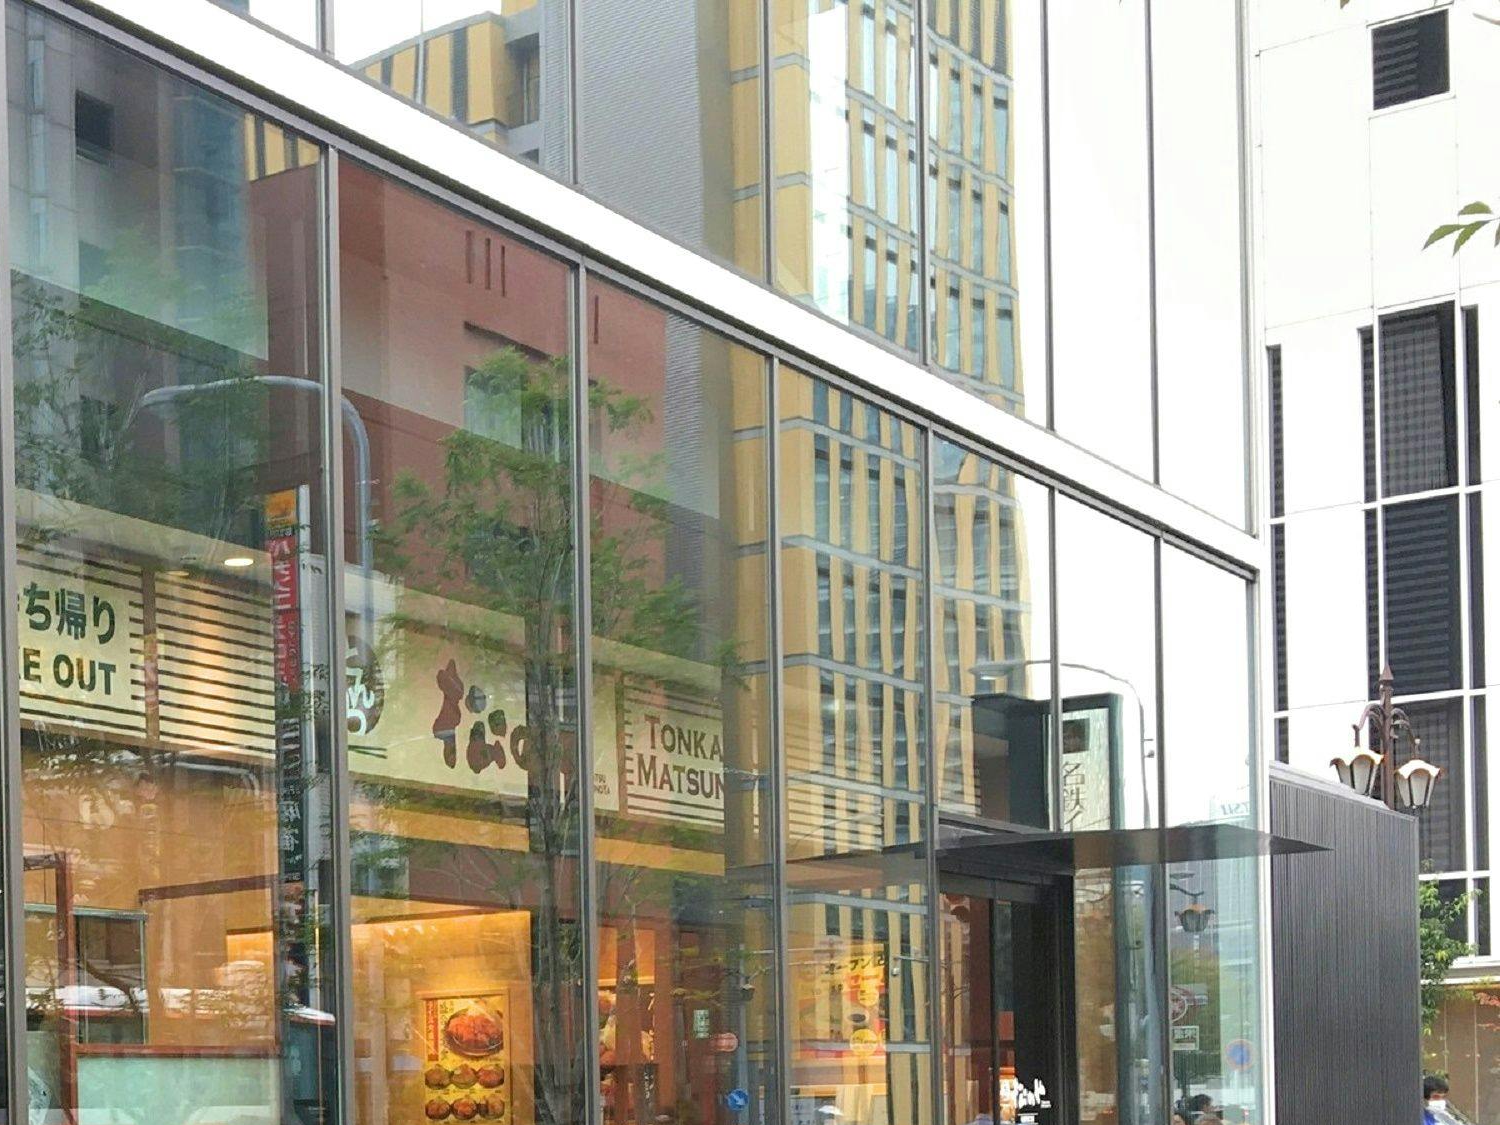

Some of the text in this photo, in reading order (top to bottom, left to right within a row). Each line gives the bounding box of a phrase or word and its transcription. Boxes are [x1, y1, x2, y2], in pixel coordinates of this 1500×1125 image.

[18, 581, 116, 645] ち帰り
[19, 647, 117, 695] E OUT
